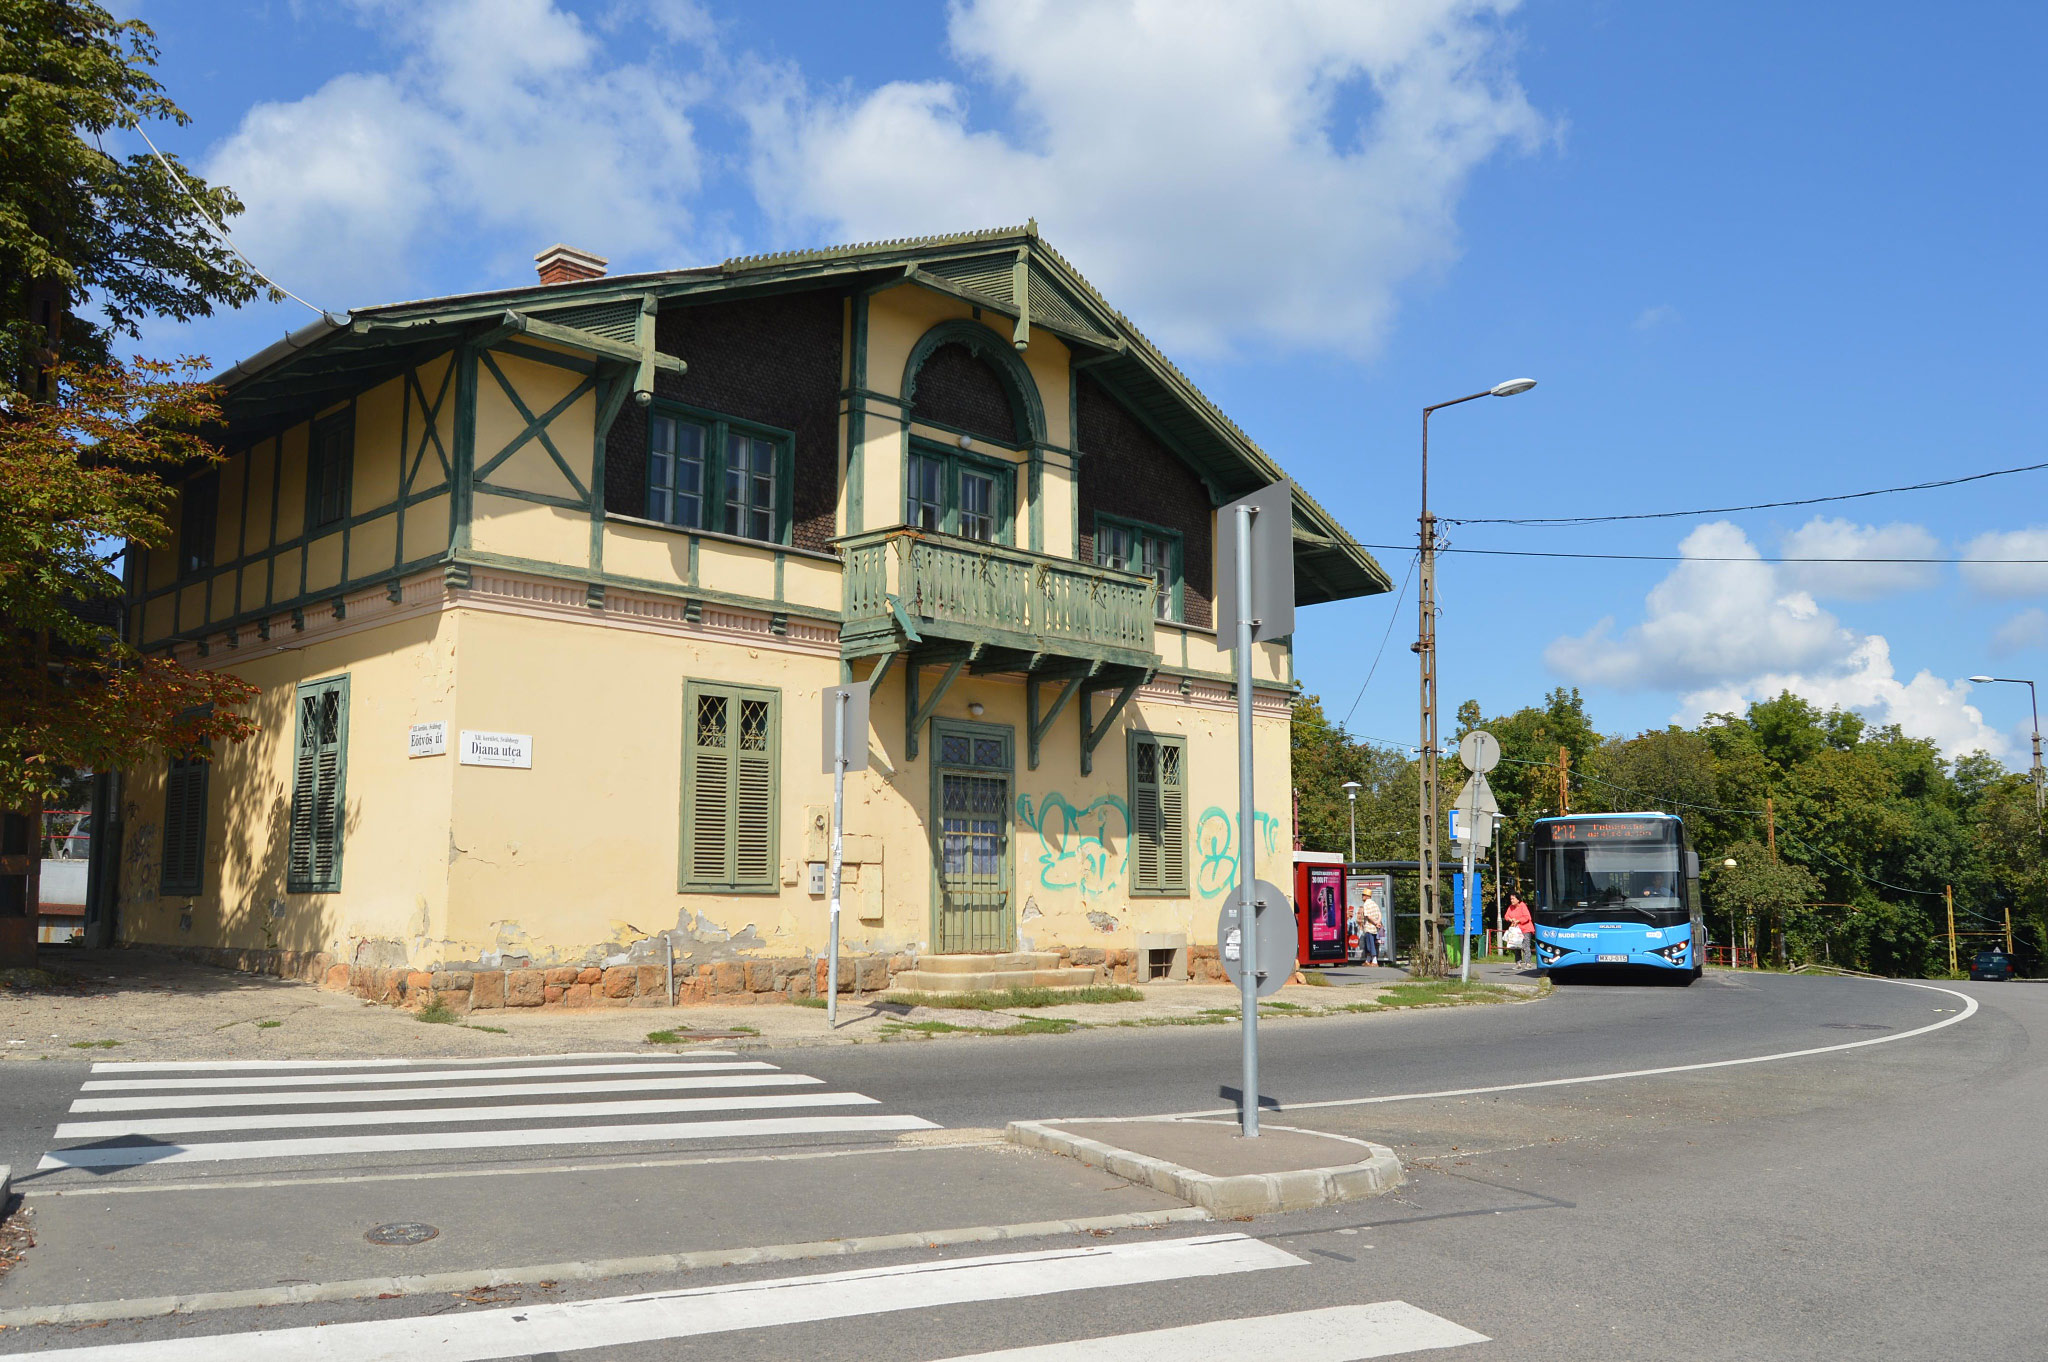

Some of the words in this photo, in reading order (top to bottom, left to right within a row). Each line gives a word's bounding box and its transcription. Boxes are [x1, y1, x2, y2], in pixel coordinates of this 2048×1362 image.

[411, 733, 433, 747] Eötvös
[435, 731, 442, 744] út
[471, 741, 499, 756] Diana
[502, 746, 521, 757] utca
[1552, 824, 1576, 840] 212
